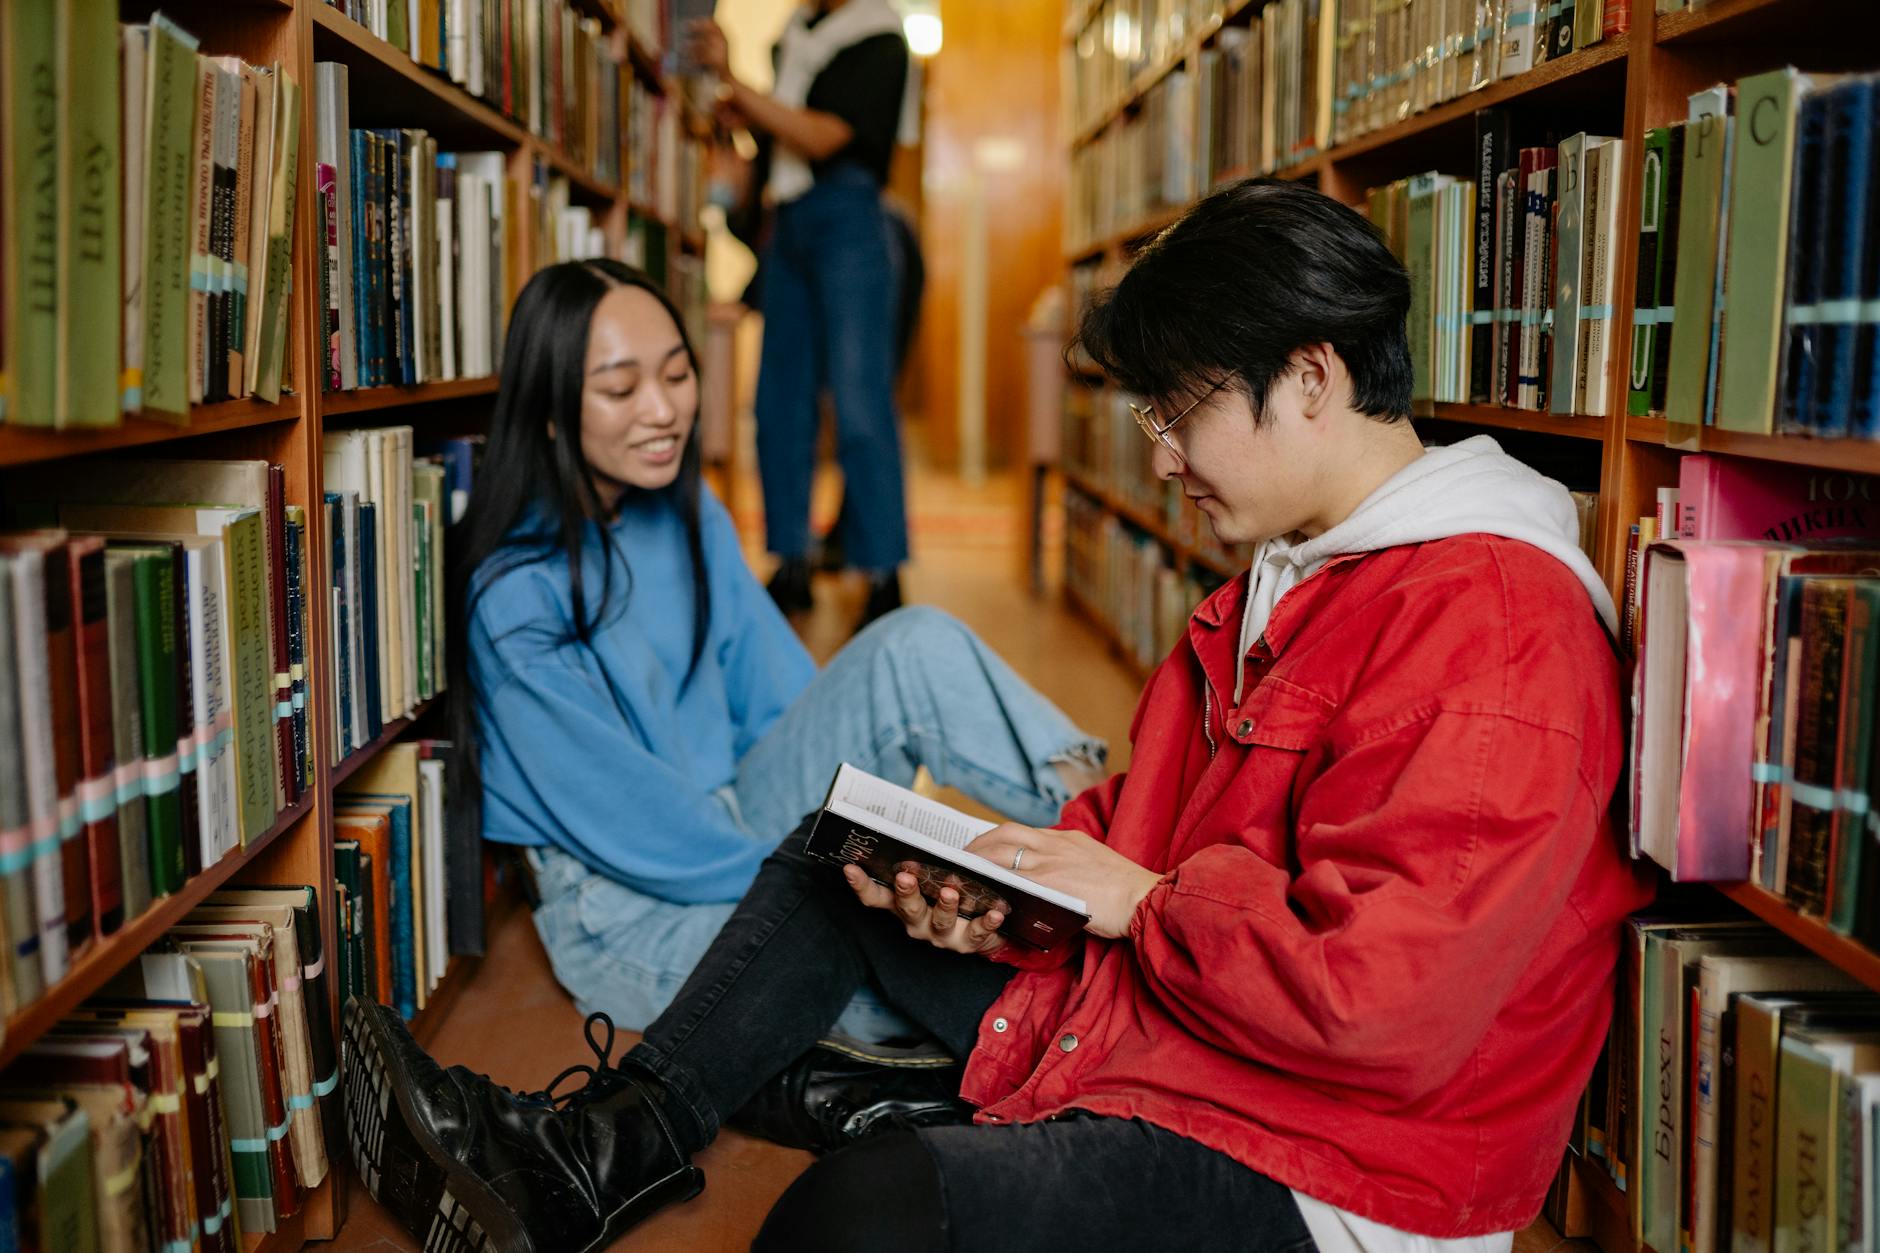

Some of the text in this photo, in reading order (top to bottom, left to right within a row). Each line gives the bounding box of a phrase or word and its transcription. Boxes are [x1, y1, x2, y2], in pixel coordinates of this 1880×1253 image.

[1478, 131, 1493, 288] КИТАЙСКАЯ ЛИТЕРАТУРА
[1654, 1028, 1674, 1163] Брехт
